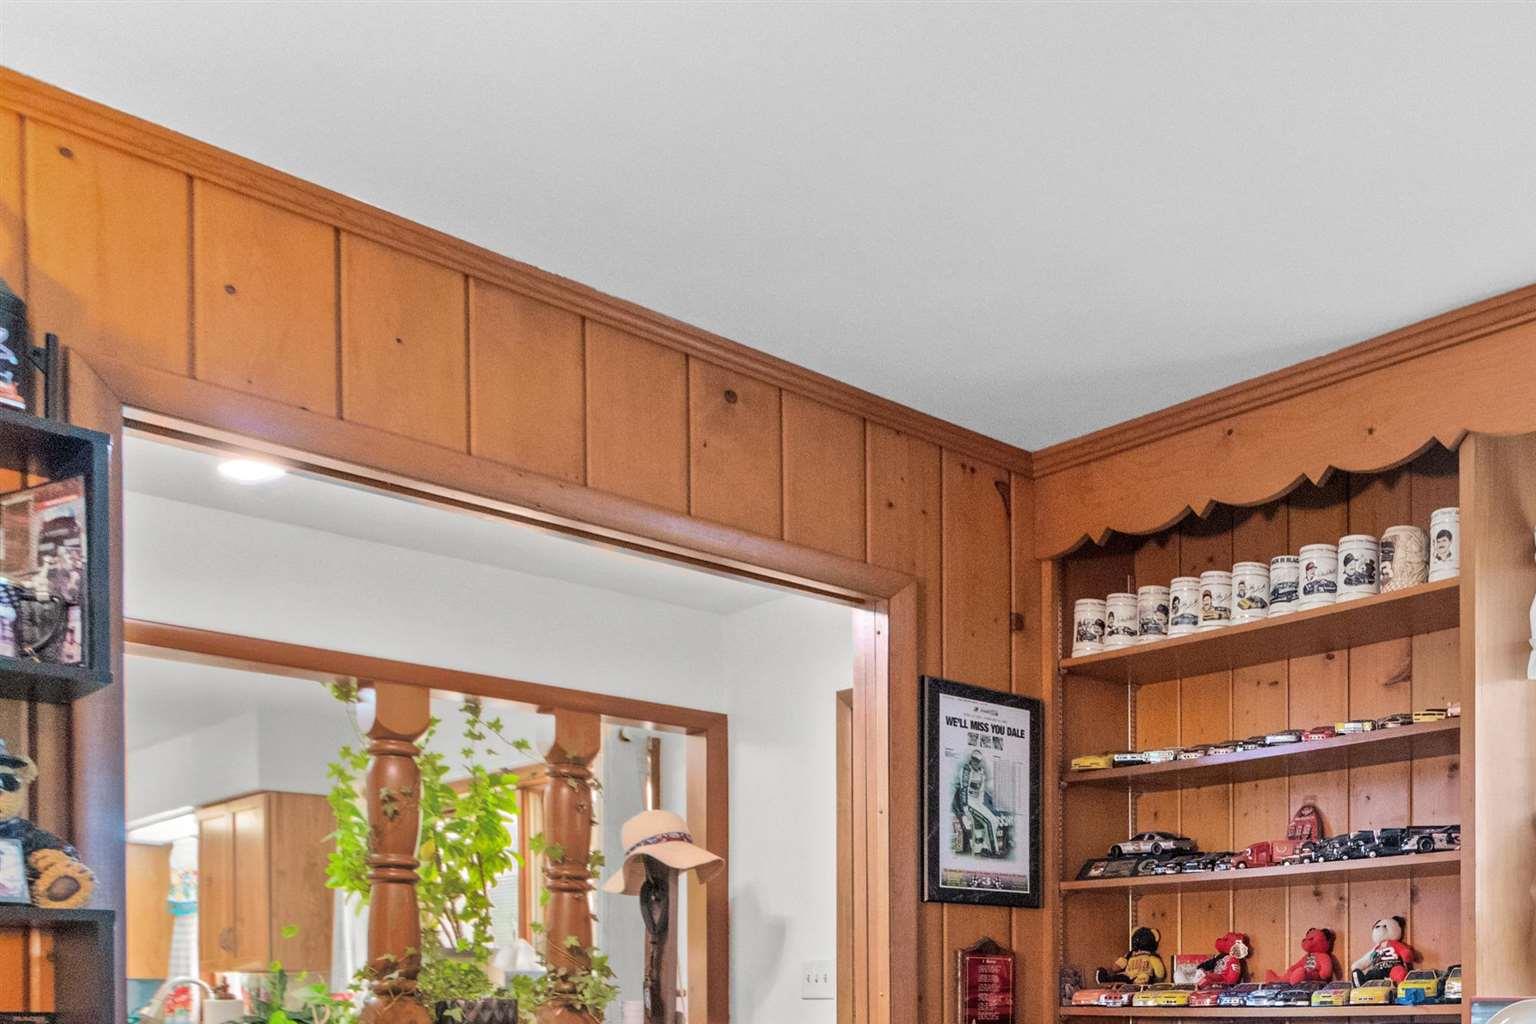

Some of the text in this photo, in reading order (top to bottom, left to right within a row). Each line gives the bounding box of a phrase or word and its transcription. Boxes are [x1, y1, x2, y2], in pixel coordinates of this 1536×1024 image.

[945, 715, 1026, 739] WE'LL MISS YOU DALE
[1380, 946, 1399, 961] 3
